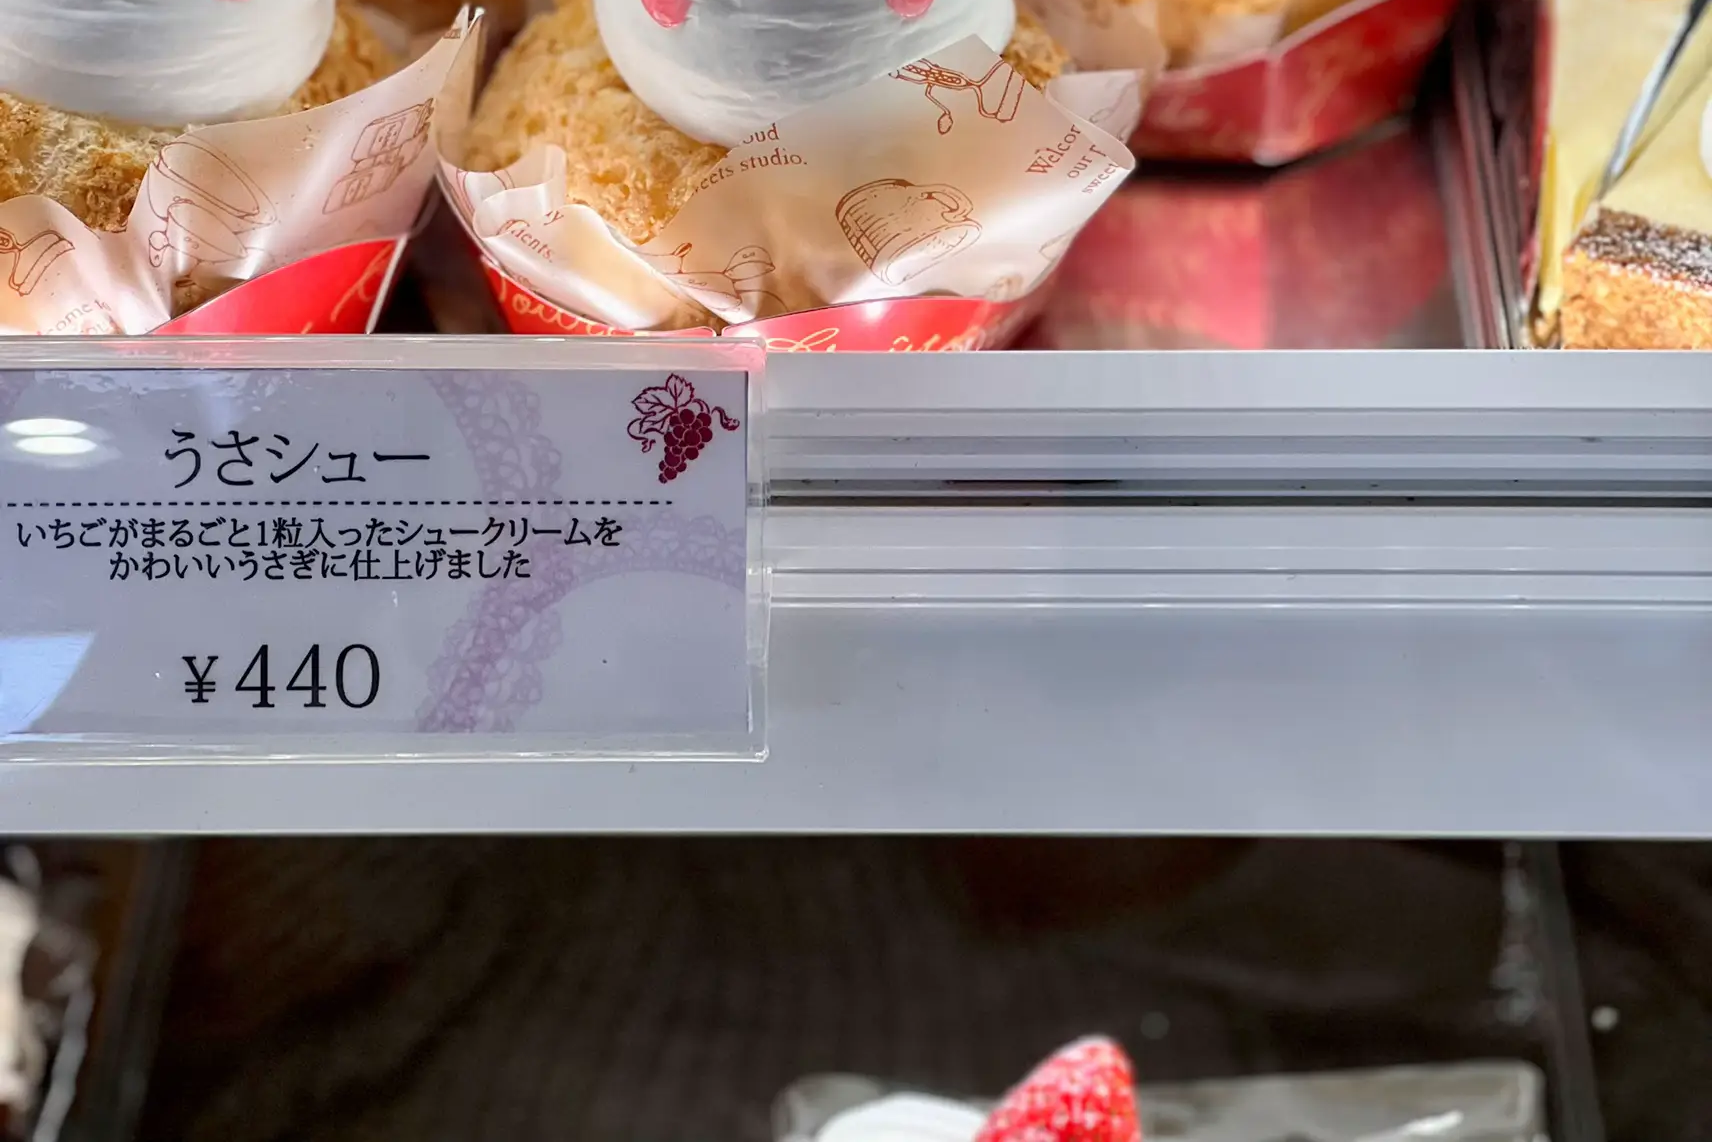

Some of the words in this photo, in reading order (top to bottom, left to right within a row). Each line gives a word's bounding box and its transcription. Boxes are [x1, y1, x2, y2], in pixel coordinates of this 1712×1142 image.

[691, 165, 735, 196] eets
[740, 147, 808, 172] studio.
[165, 429, 431, 489] うさシュー
[16, 516, 623, 551] いちごがまるごと1粒入ったシュークリームを
[109, 548, 532, 582] かわいいうさぎに仕上げました
